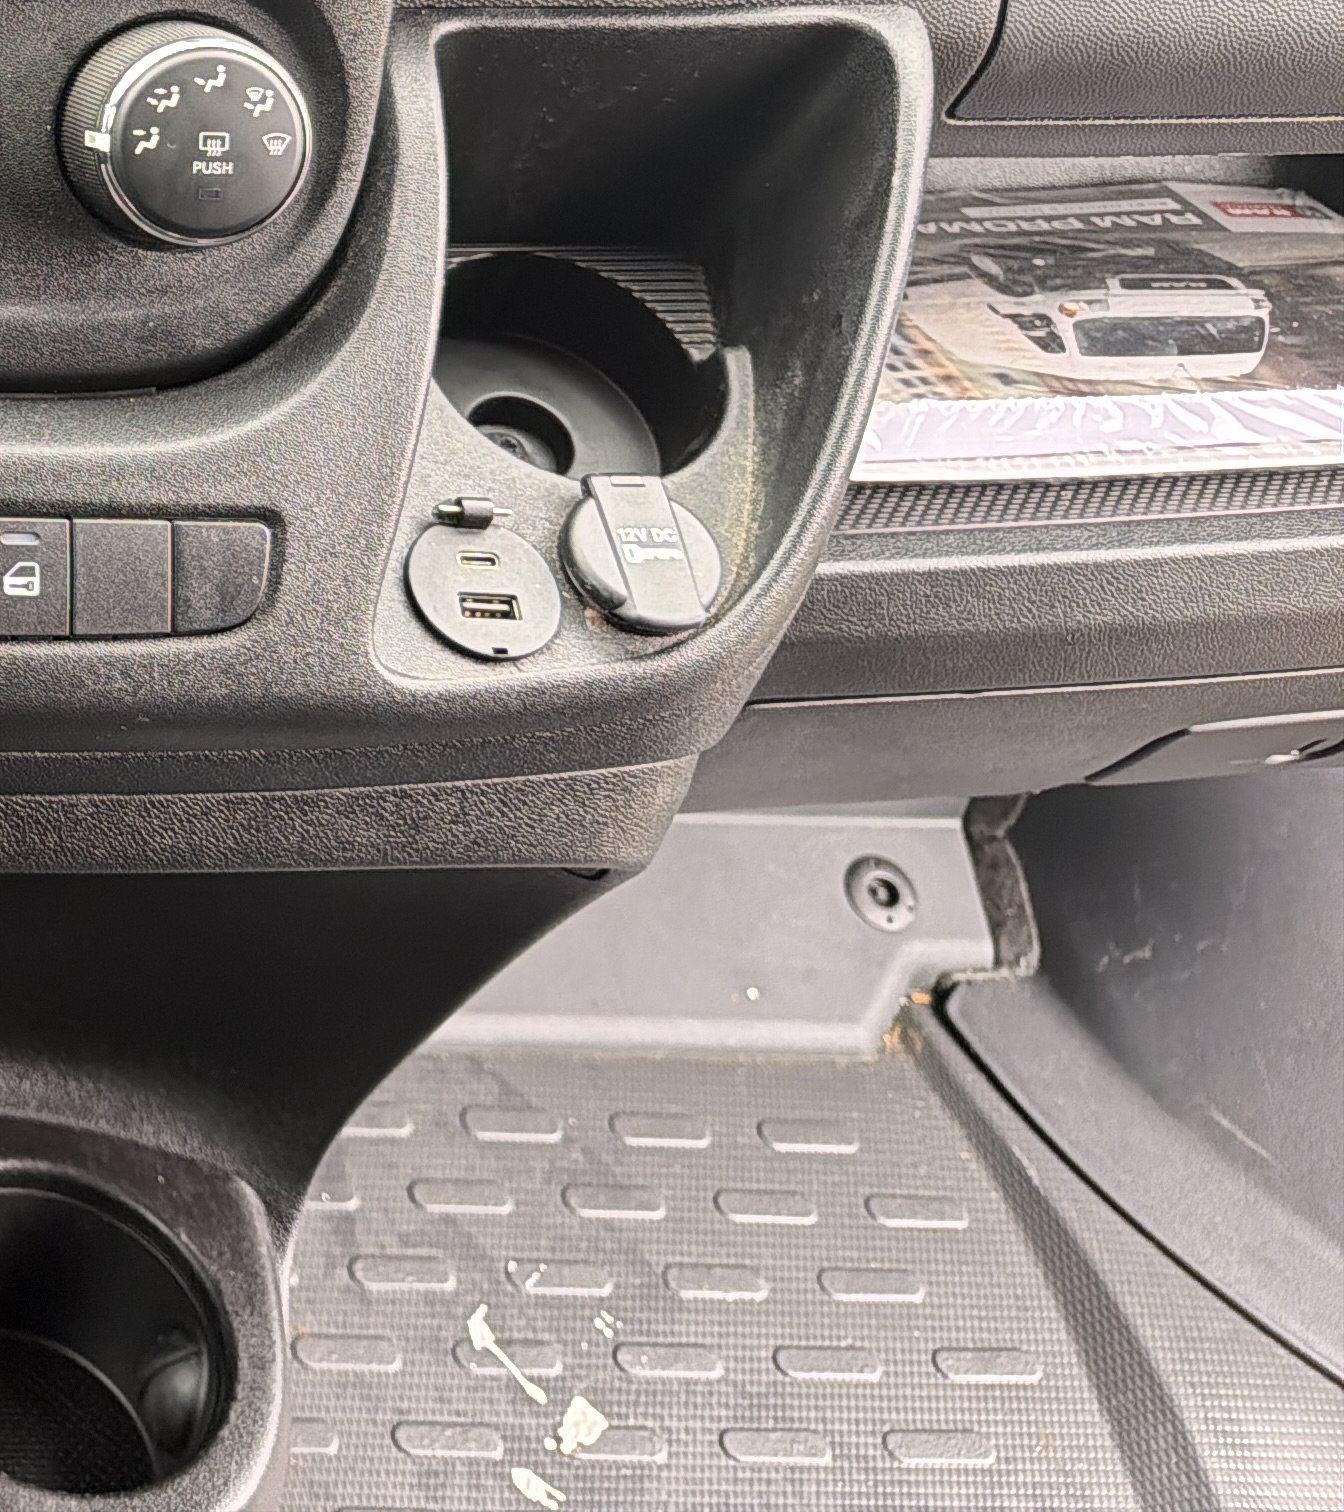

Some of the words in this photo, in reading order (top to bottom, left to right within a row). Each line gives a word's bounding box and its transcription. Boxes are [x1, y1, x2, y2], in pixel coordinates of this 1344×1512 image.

[191, 160, 234, 176] PUSH
[1090, 212, 1204, 229] RAM
[616, 527, 648, 543] 12V
[649, 527, 678, 543] DC
